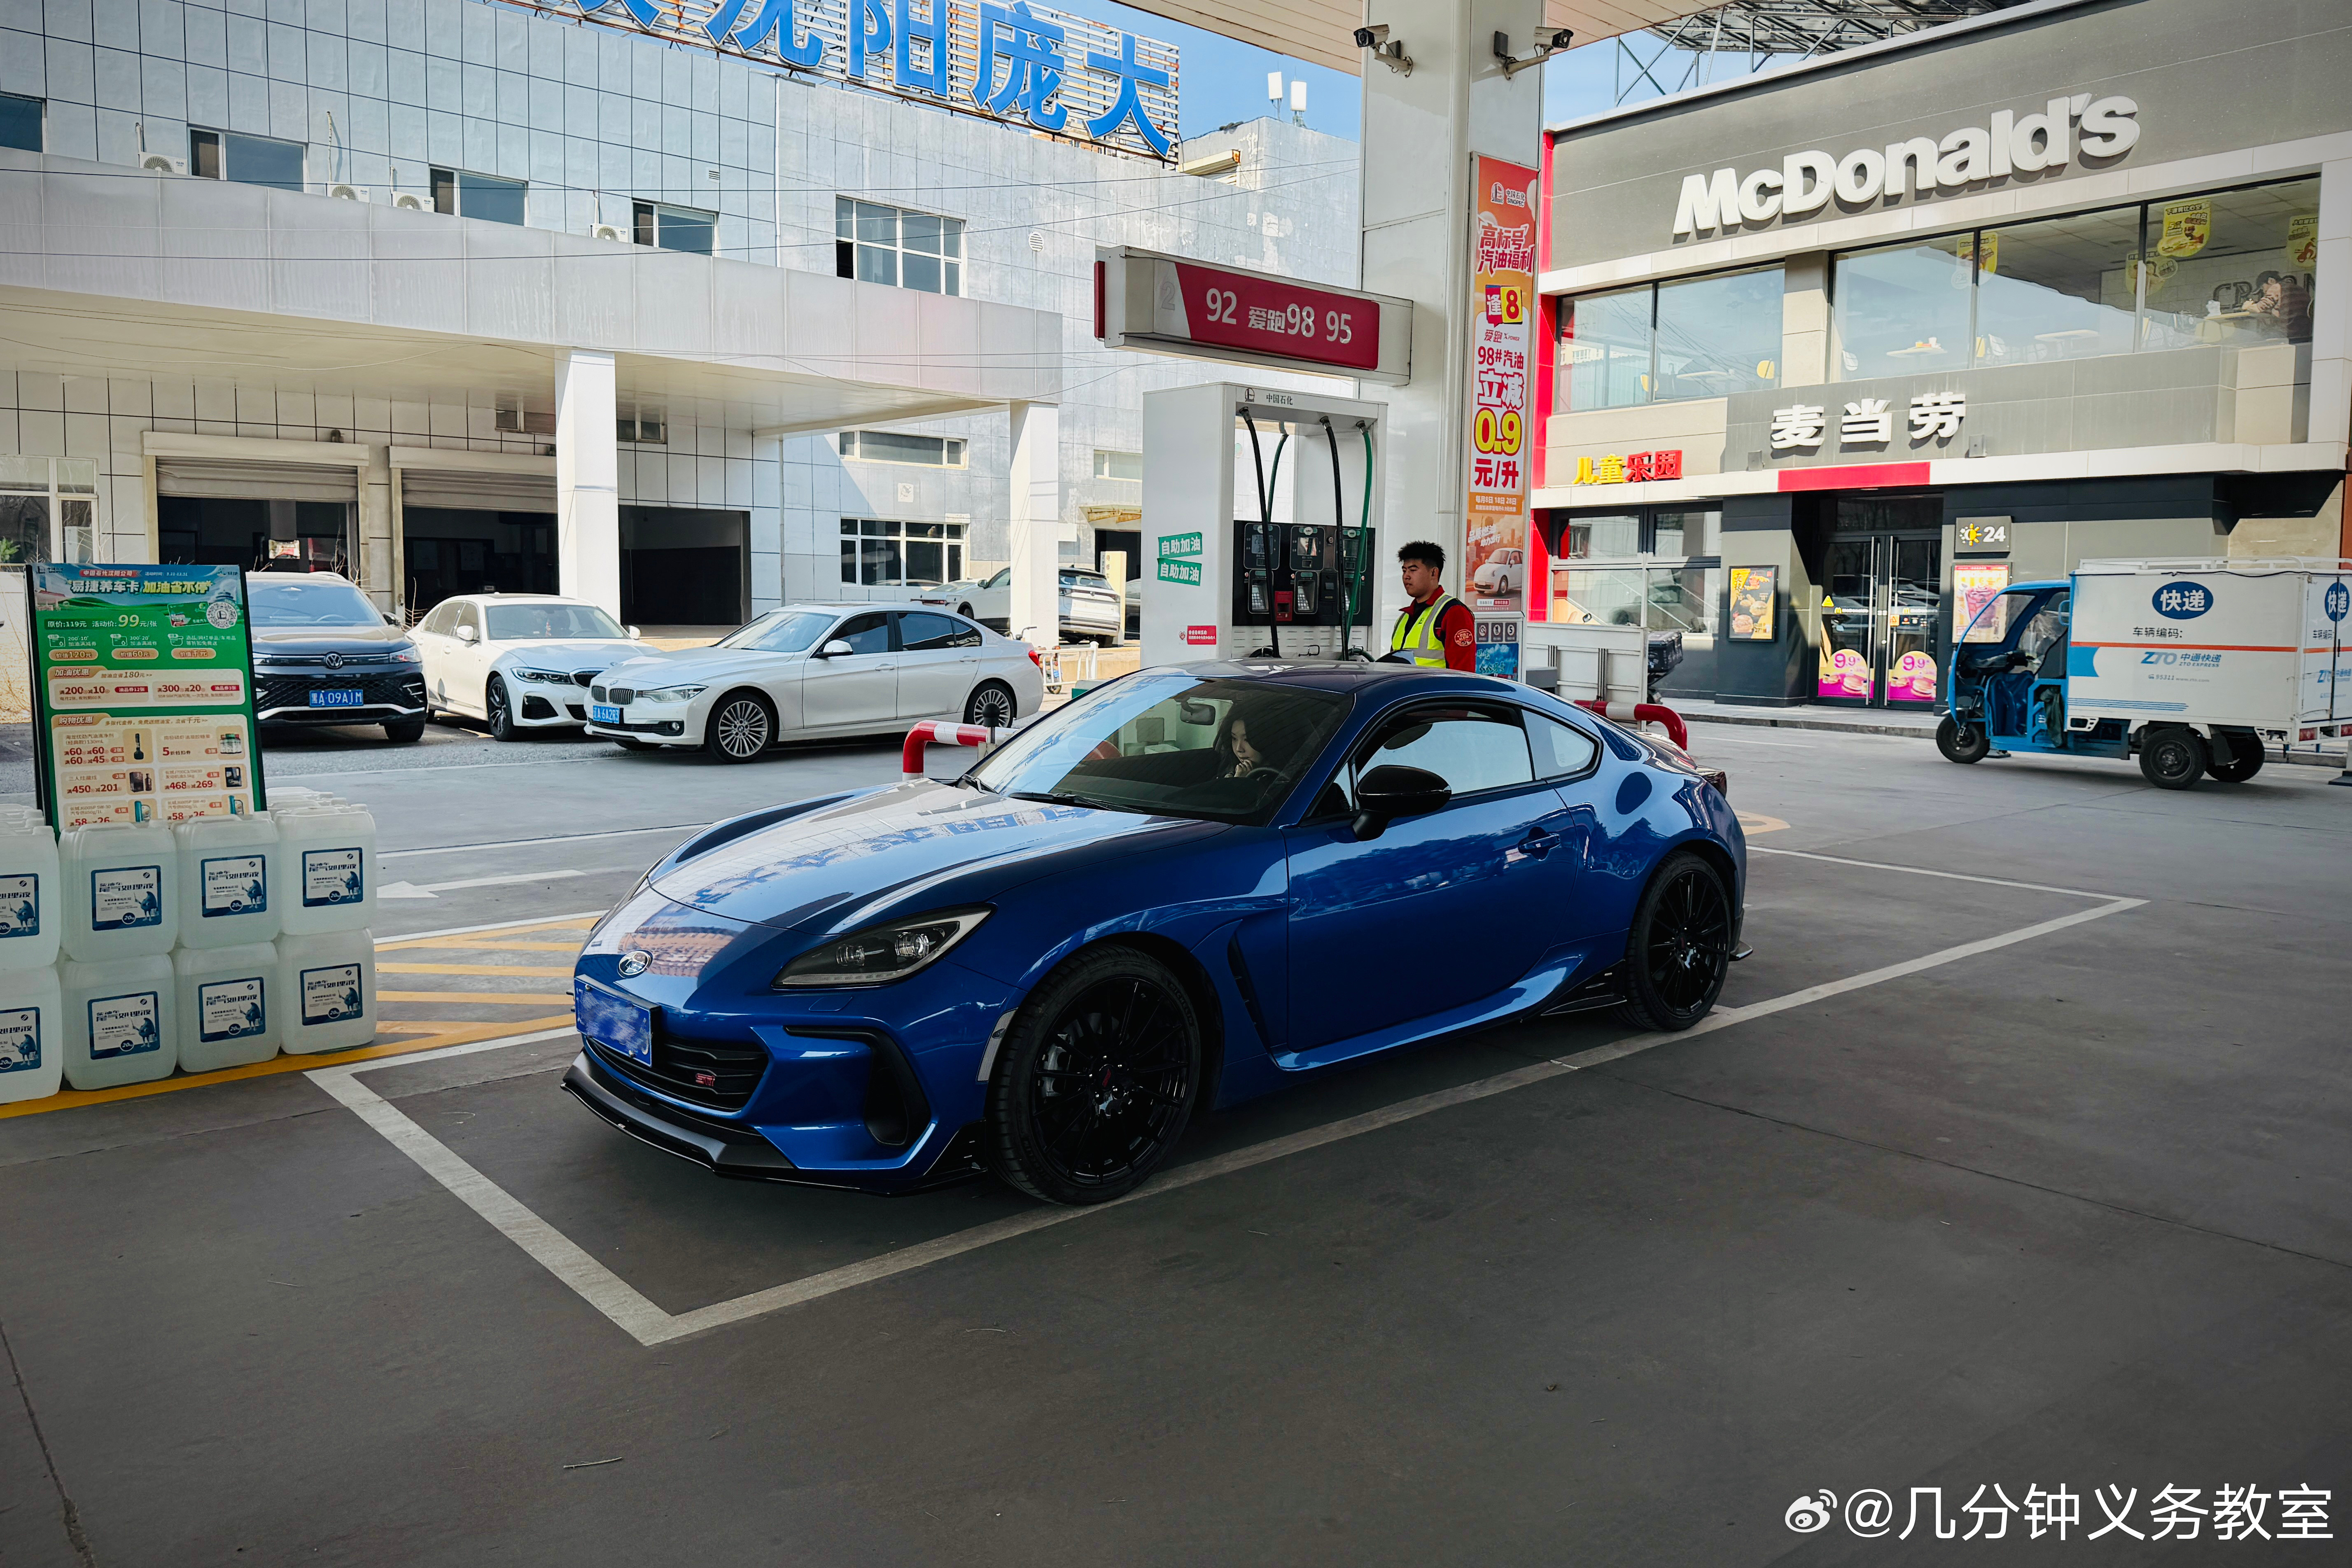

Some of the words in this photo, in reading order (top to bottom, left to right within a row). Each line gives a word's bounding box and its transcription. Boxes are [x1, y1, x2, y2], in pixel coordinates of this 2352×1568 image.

[1673, 92, 2140, 234] McDonald's
[1506, 189, 1525, 201] 中国石化
[1507, 198, 1524, 206] SINOPEC
[1480, 222, 1528, 250] 高标号
[1477, 245, 1535, 276] 汽油福利
[1206, 288, 1237, 324] 92
[1248, 303, 1315, 338] 爱跑98
[1326, 310, 1352, 344] 95
[1486, 289, 1520, 320] 逢8
[1484, 329, 1503, 343] 爱跑
[1478, 346, 1524, 369] 98#汽油
[1266, 393, 1293, 406] 中国石化
[1477, 369, 1524, 410] 立减
[1474, 407, 1522, 456] 0.9
[1771, 392, 1967, 450] 麦当劳
[1475, 458, 1519, 489] 元/升
[1572, 449, 1682, 485] 儿童乐园
[1161, 536, 1201, 555] 自助加油
[1983, 525, 2006, 543] 24
[1160, 562, 1199, 582] 自助加油
[71, 580, 139, 593] 易捷养车卡
[142, 580, 208, 594] 加油省不停
[2160, 589, 2206, 612] 快递
[2328, 590, 2347, 614] 快递
[2133, 627, 2183, 639] 车辆编码:
[2141, 651, 2177, 665] ZTO
[2180, 653, 2222, 663] 中通快递
[54, 668, 90, 677] 加油优惠
[58, 716, 94, 726] 购物优惠
